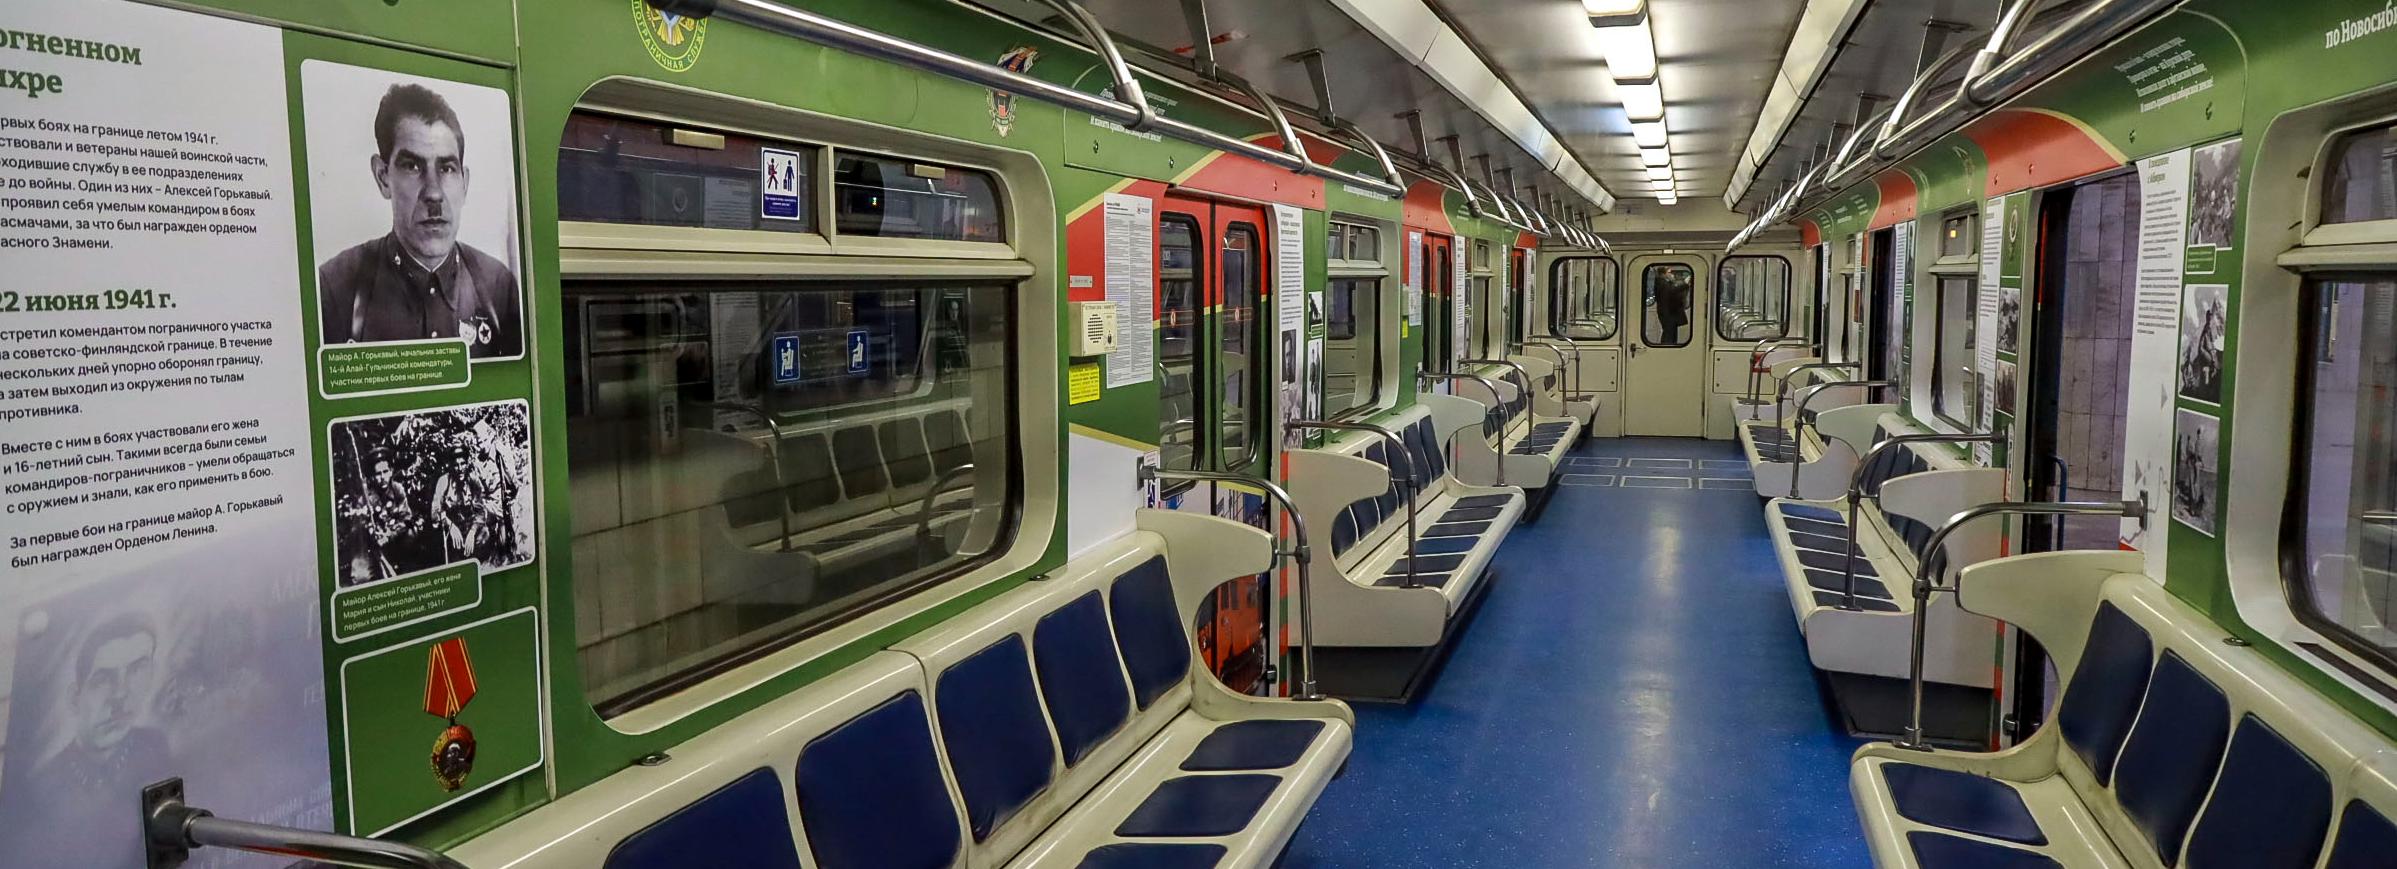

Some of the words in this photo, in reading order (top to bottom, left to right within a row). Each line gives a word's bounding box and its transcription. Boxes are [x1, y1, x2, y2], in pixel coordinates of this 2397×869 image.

[2325, 28, 2340, 49] по
[0, 117, 36, 131] рвых
[38, 118, 71, 133] боях
[73, 124, 89, 134] на
[91, 125, 144, 139] границе
[146, 130, 183, 142] летом
[184, 131, 208, 144] 1941
[210, 136, 218, 145] г.
[65, 142, 74, 152] и
[76, 143, 138, 158] ветераны
[139, 148, 178, 160] нашей
[180, 151, 233, 164] воинской
[234, 155, 268, 167] части,
[72, 162, 120, 177] службу
[122, 165, 130, 175] в
[131, 166, 147, 176] ее
[148, 167, 244, 182] подразделениях
[8, 178, 27, 190] до
[29, 177, 76, 191] войны.
[77, 179, 113, 193] Один
[114, 183, 129, 194] из
[131, 184, 153, 194] них
[164, 184, 212, 197] Алексей
[213, 186, 273, 201] Горькавый.
[1, 197, 60, 211] проявил
[62, 198, 94, 211] себя
[96, 201, 146, 214] умелым
[148, 204, 220, 218] командиром
[222, 207, 229, 216] в
[230, 205, 256, 216] боях
[0, 217, 73, 231] асмачами,
[75, 219, 90, 230] за
[92, 220, 115, 230] что
[116, 218, 141, 231] был
[143, 222, 207, 235] награжден
[208, 223, 257, 236] орденом
[0, 237, 50, 248] асного
[52, 236, 113, 249] Знамени.
[24, 294, 100, 312] июня
[103, 289, 156, 310] 1941
[158, 293, 176, 309] г.
[0, 328, 57, 344] стретил
[59, 325, 146, 338] комендантом
[148, 322, 229, 336] пограничного
[230, 320, 272, 334] участка
[12, 340, 165, 360] советско-финляндской
[167, 340, 217, 354] границе.
[219, 337, 227, 349] В
[228, 337, 273, 348] течение
[77, 361, 110, 377] дней
[111, 361, 157, 376] упорно
[158, 357, 215, 372] оборонял
[216, 355, 263, 369] границу,
[8, 387, 49, 400] затем
[51, 383, 108, 396] выходил
[110, 381, 125, 392] из
[126, 377, 192, 392] окружения
[193, 375, 208, 385] по
[210, 373, 245, 384] тылам
[0, 404, 83, 423] противника.
[1, 440, 53, 456] Вместе
[55, 439, 63, 449] с
[65, 436, 92, 448] ним
[93, 435, 102, 445] в
[103, 432, 134, 444] боях
[135, 424, 209, 443] участвовали
[210, 422, 230, 432] его
[232, 418, 260, 430] жена
[3, 464, 12, 475] и
[14, 454, 84, 473] 16-летний
[85, 453, 114, 465] сын.
[115, 447, 161, 461] Такими
[163, 442, 203, 455] всегда
[204, 439, 233, 450] были
[234, 435, 267, 447] семьи
[5, 462, 186, 495] командиров-пограничников
[196, 456, 231, 472] умели
[232, 448, 295, 465] обращаться
[6, 503, 15, 514] с
[17, 495, 79, 514] оружием
[81, 493, 89, 503] и
[91, 488, 132, 502] знали,
[134, 484, 155, 495] как
[156, 481, 177, 492] его
[178, 473, 240, 491] применить
[241, 471, 248, 480] в
[249, 467, 274, 479] бою.
[10, 536, 27, 549] За
[29, 529, 80, 547] первые
[81, 524, 106, 537] бои
[108, 522, 123, 533] на
[125, 513, 175, 532] границе
[177, 507, 213, 521] майор
[214, 503, 225, 515] А.
[227, 494, 283, 514] Горькавый
[11, 555, 39, 569] был
[41, 542, 113, 563] награжден
[114, 532, 170, 552] Орденом
[172, 524, 218, 540] Ленина.
